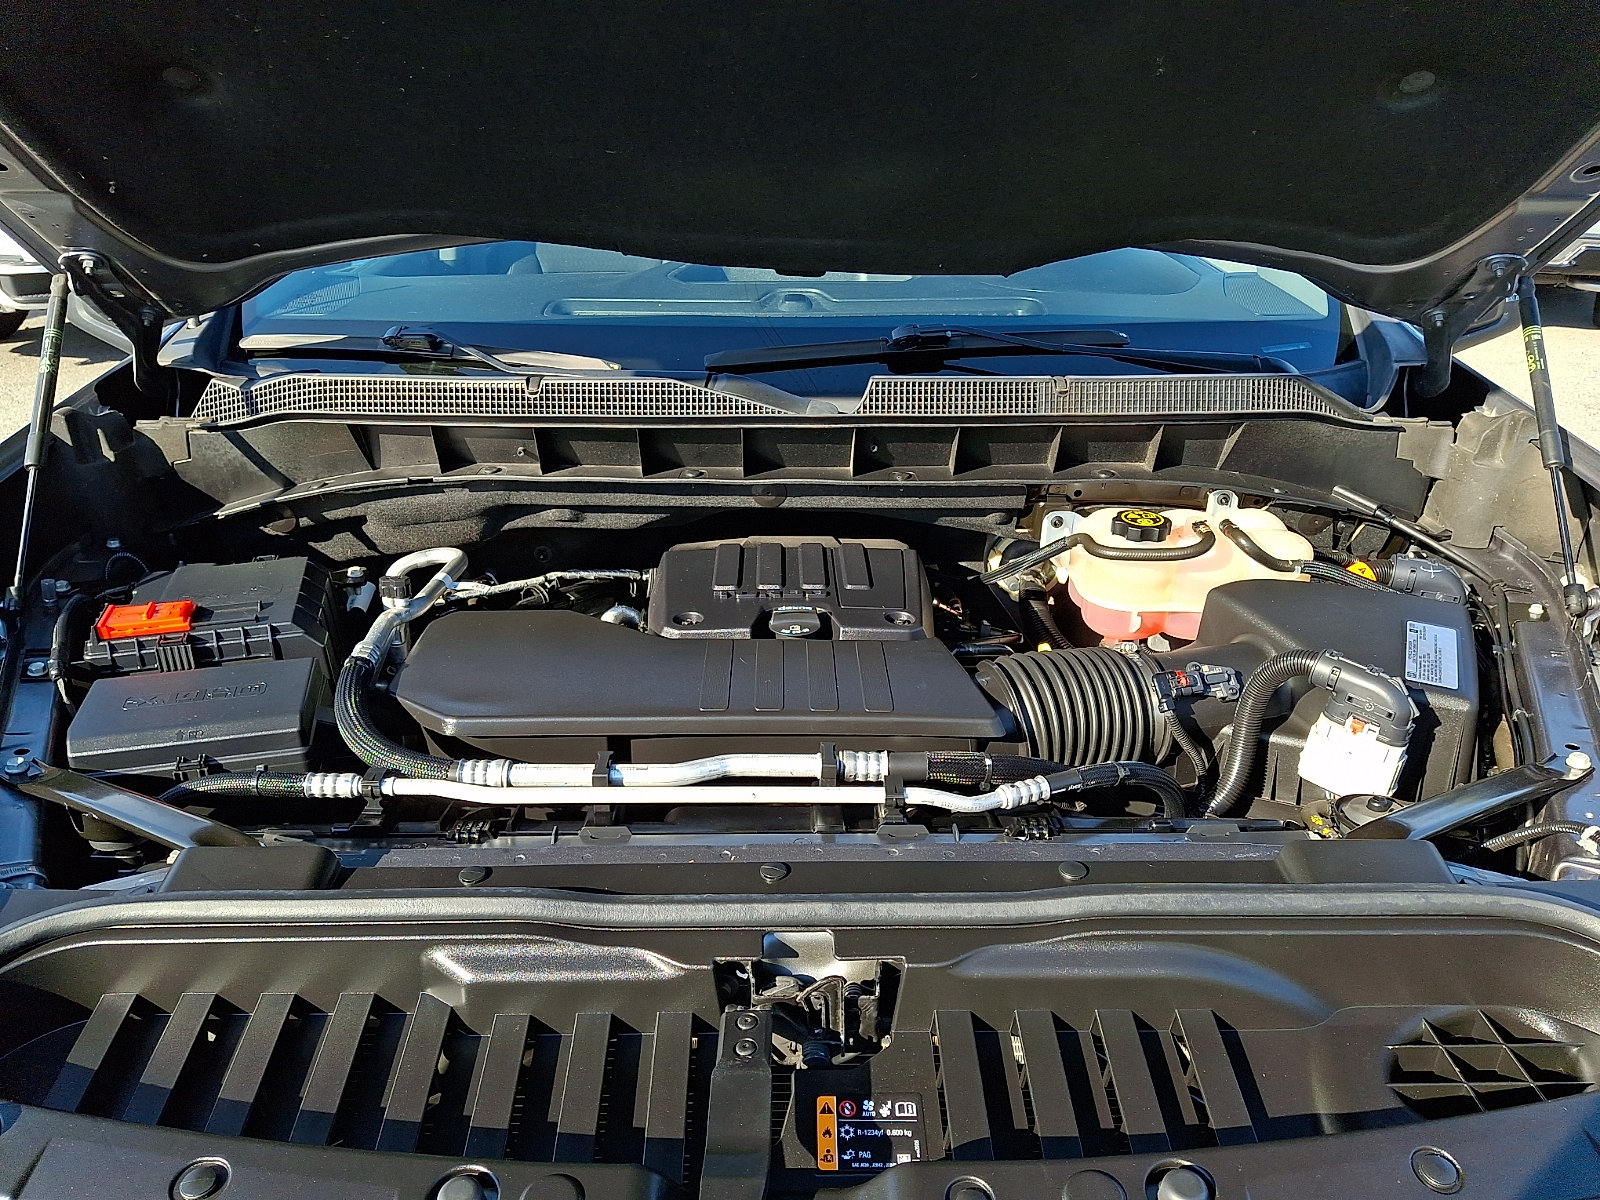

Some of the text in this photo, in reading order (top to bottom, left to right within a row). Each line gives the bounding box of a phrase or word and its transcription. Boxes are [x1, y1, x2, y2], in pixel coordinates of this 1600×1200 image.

[857, 1129, 884, 1137] R-1234yf
[904, 1129, 912, 1138] kg
[858, 1151, 872, 1159] PAG
